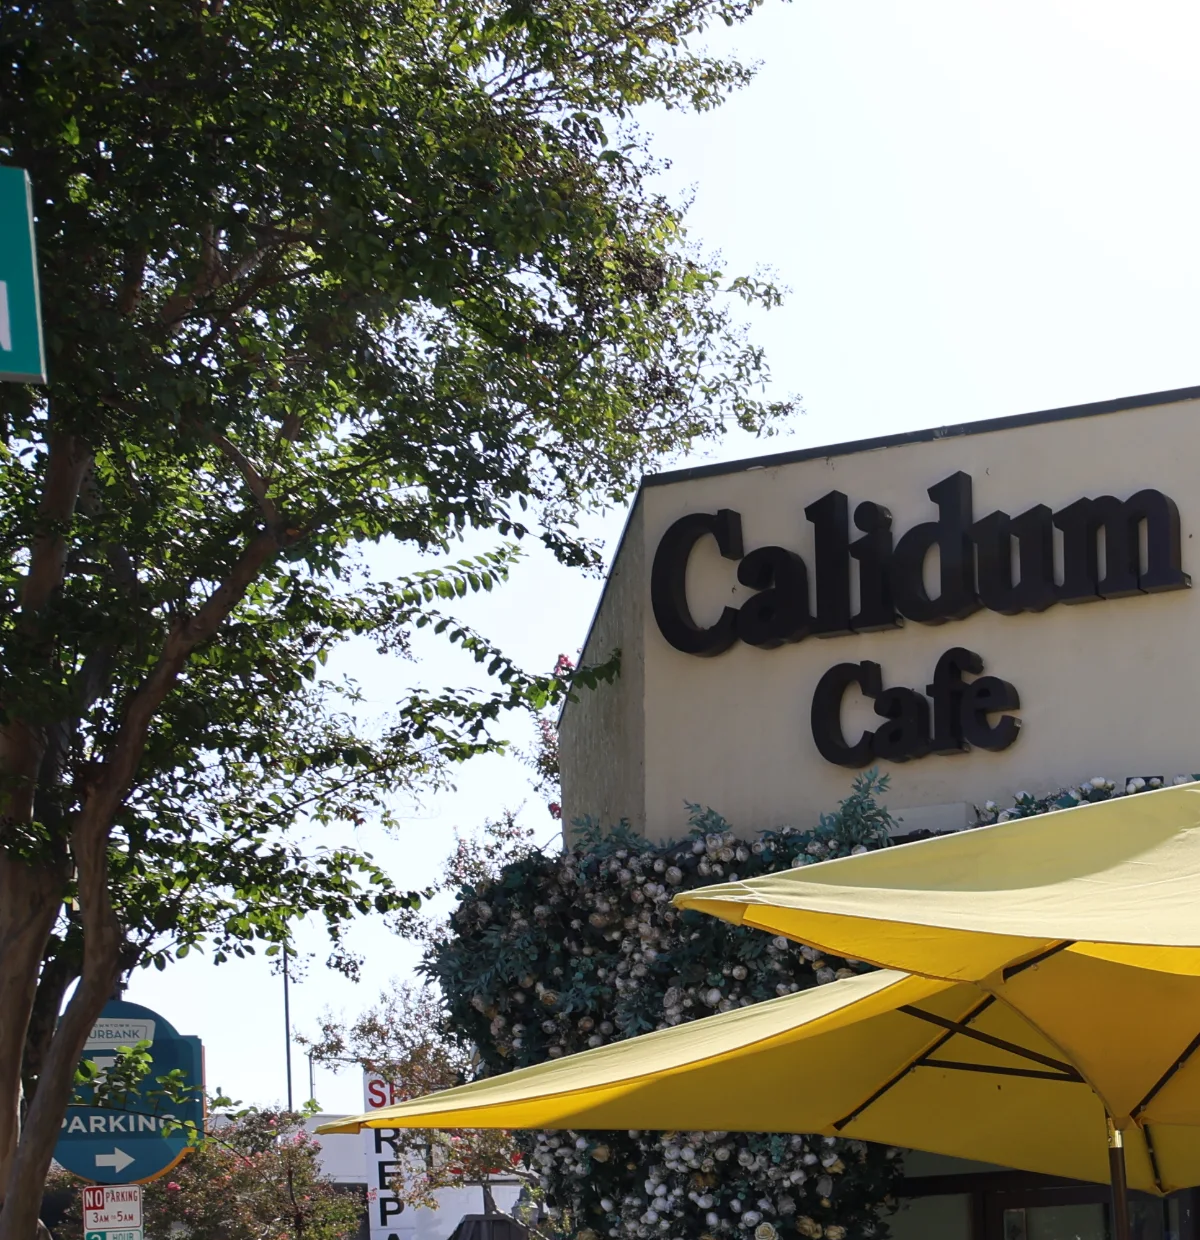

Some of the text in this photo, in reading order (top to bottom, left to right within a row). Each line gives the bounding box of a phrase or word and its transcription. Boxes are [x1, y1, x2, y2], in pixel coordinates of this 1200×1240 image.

[650, 471, 1192, 657] Calidum
[811, 647, 1022, 768] Cafe
[88, 1029, 140, 1039] URBANK
[85, 1189, 138, 1208] NO PARKING
